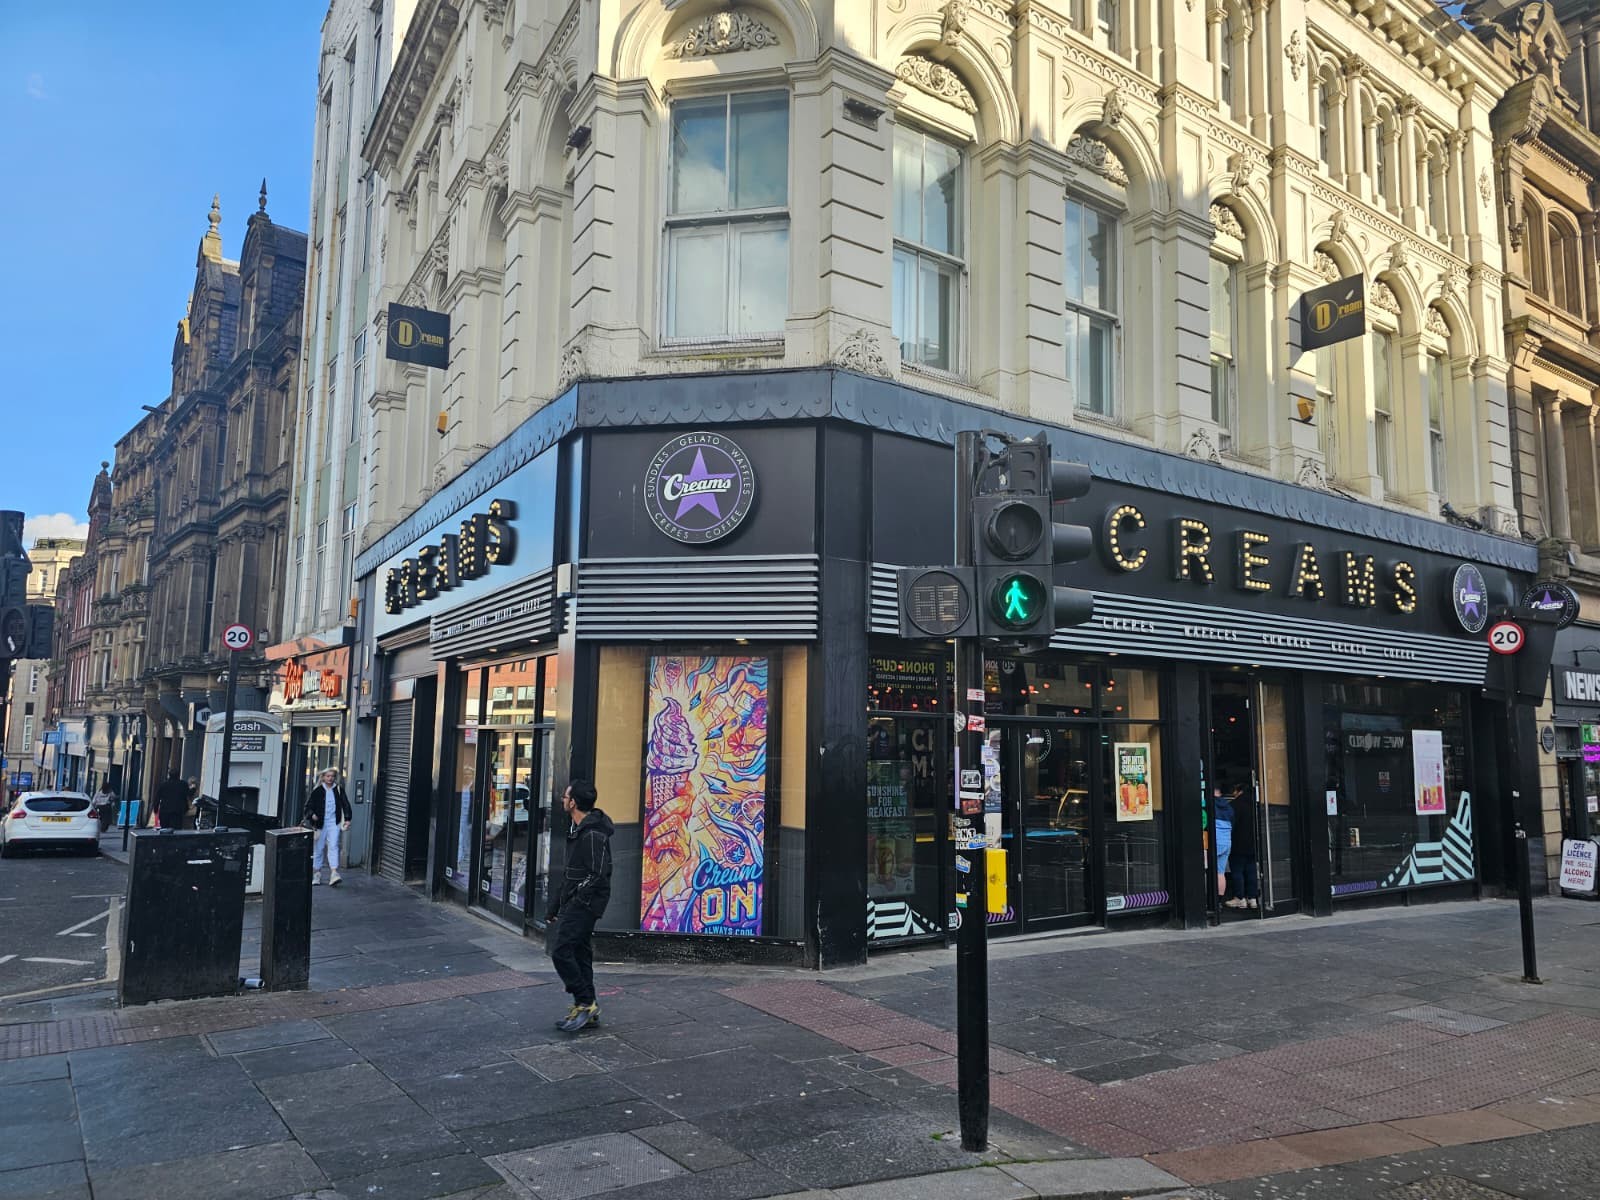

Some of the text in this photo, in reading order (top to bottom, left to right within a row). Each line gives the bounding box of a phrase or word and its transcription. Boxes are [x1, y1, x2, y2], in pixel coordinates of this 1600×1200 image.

[679, 435, 720, 446] GELATO
[647, 450, 669, 499] SUNDAES
[731, 448, 752, 496] WAFFLES
[663, 473, 732, 502] Creams
[654, 512, 689, 540] CREPES
[705, 510, 743, 539] COFFEE
[385, 498, 518, 615] CREAMS
[1103, 503, 1418, 615] CREAMS
[227, 631, 250, 643] 20
[1103, 616, 1155, 633] CREPES
[1184, 624, 1238, 641] WAFFLES
[1262, 633, 1312, 649] SUNDAES
[1383, 647, 1416, 661] COFFEE
[1494, 630, 1519, 645] 20
[233, 722, 261, 731] cash
[867, 806, 907, 817] REAKFAST
[1567, 849, 1592, 858] LICENCE
[1573, 842, 1585, 850] OFF
[692, 857, 763, 891] Cream
[1564, 867, 1592, 878] ALCOHOL
[701, 881, 757, 926] ON
[704, 924, 734, 936] ALWAYS
